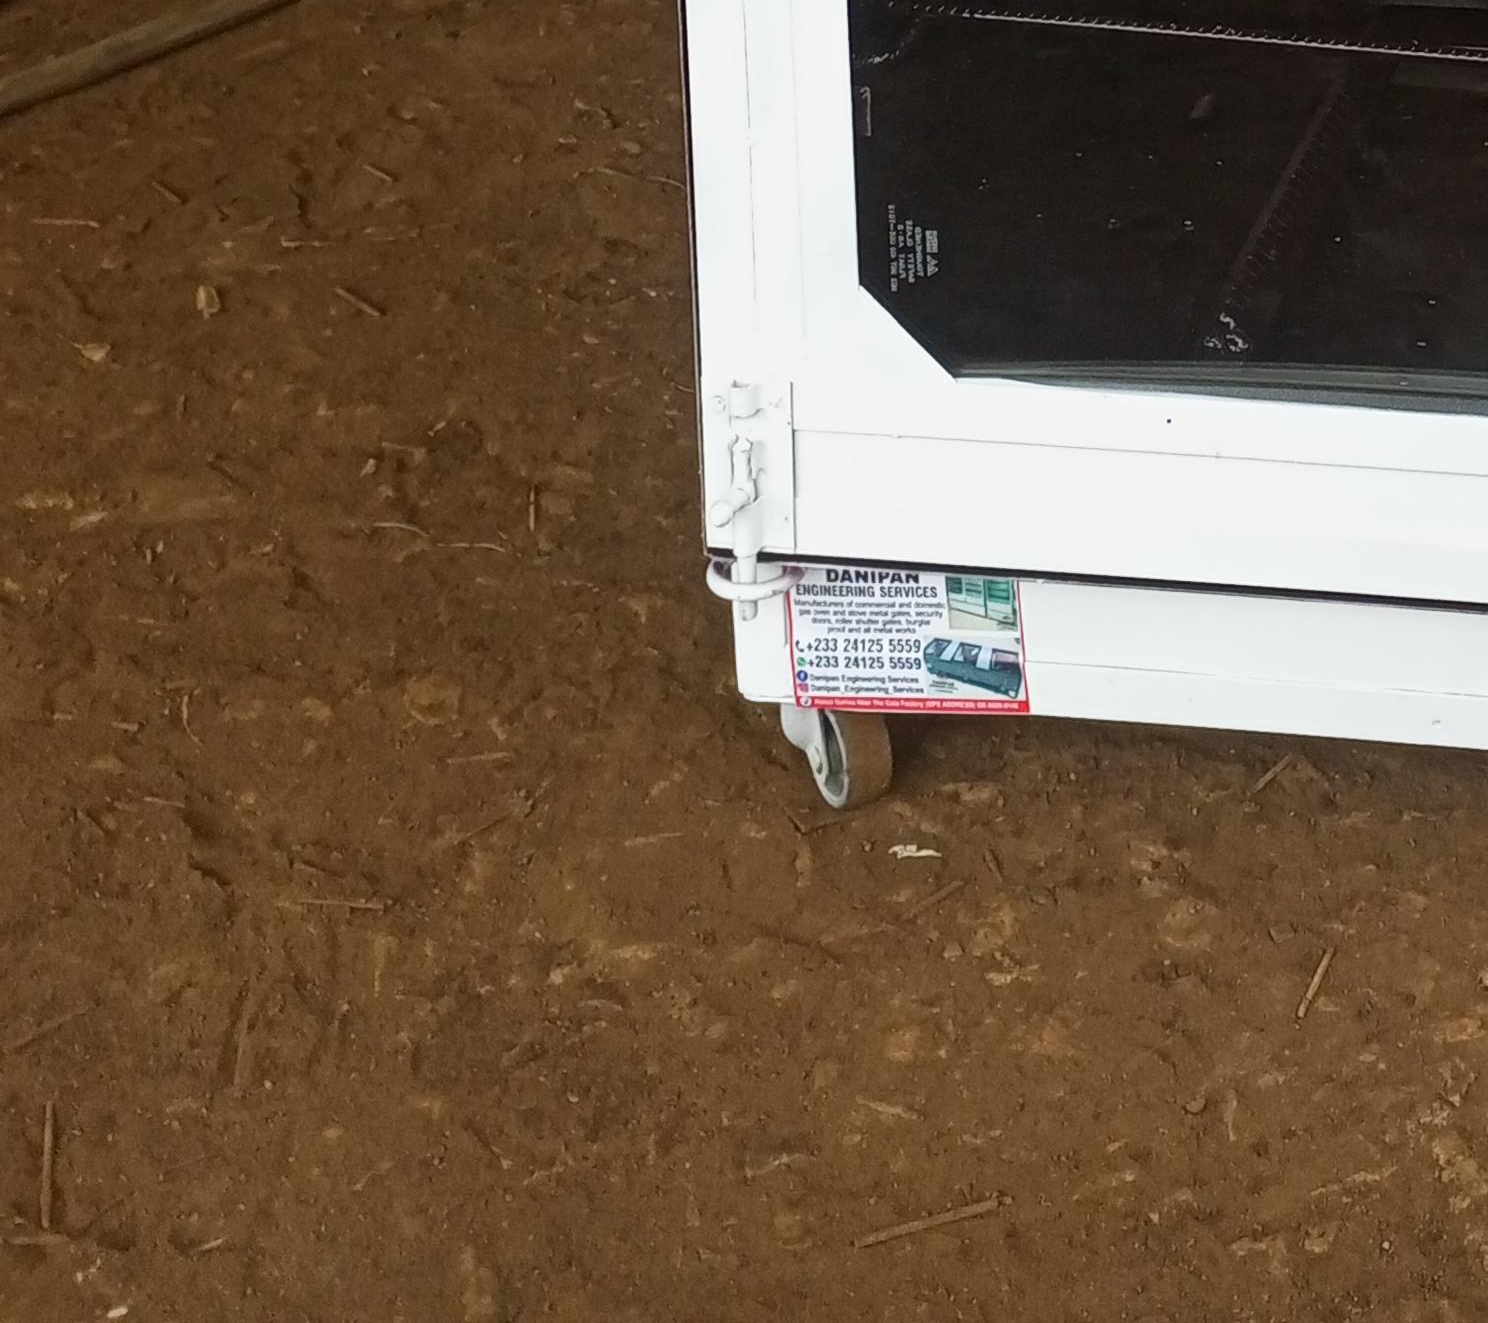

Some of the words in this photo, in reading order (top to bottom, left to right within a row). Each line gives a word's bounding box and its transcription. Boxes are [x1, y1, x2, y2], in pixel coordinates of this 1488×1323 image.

[826, 568, 920, 584] DANIPAN
[796, 584, 876, 598] ENGINEERING
[880, 585, 938, 598] SERVICES
[794, 599, 845, 608] Manufacturers
[915, 610, 943, 619] security
[848, 626, 861, 634] and
[807, 638, 838, 652] +233
[843, 638, 884, 653] 24125
[889, 639, 921, 653] 5559
[808, 656, 839, 668] +233
[844, 656, 885, 669] 24125
[889, 657, 922, 670] 5559
